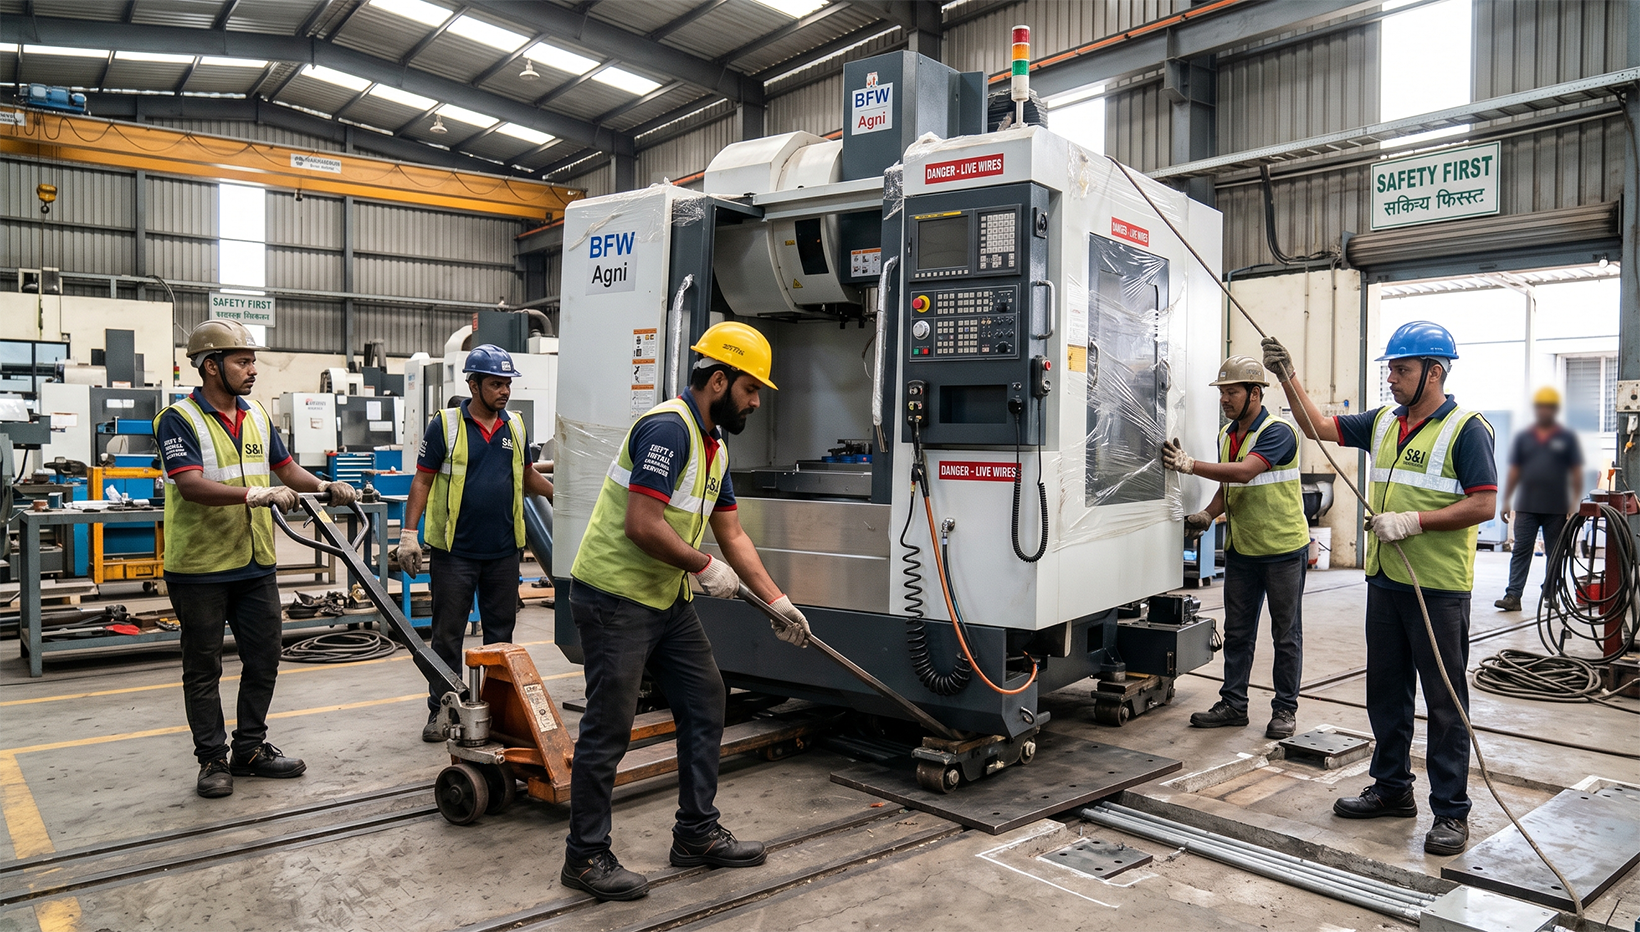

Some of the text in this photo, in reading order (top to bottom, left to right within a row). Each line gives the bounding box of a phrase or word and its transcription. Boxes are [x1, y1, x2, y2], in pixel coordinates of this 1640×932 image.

[855, 87, 890, 108] BFW
[858, 111, 886, 130] Agni
[926, 165, 956, 180] DANGER
[961, 162, 977, 175] LIVE
[978, 158, 1002, 172] WIRES
[1377, 155, 1493, 193] SAFETY FIRST
[589, 231, 635, 259] BFW
[591, 262, 627, 288] Agni
[213, 297, 272, 309] SAFETY FIRST
[245, 443, 263, 454] S&I
[1405, 448, 1426, 464] S&I
[941, 465, 970, 476] DANGER
[975, 466, 991, 477] LIVE
[992, 467, 1016, 478] WIRES
[706, 477, 720, 493] &I
